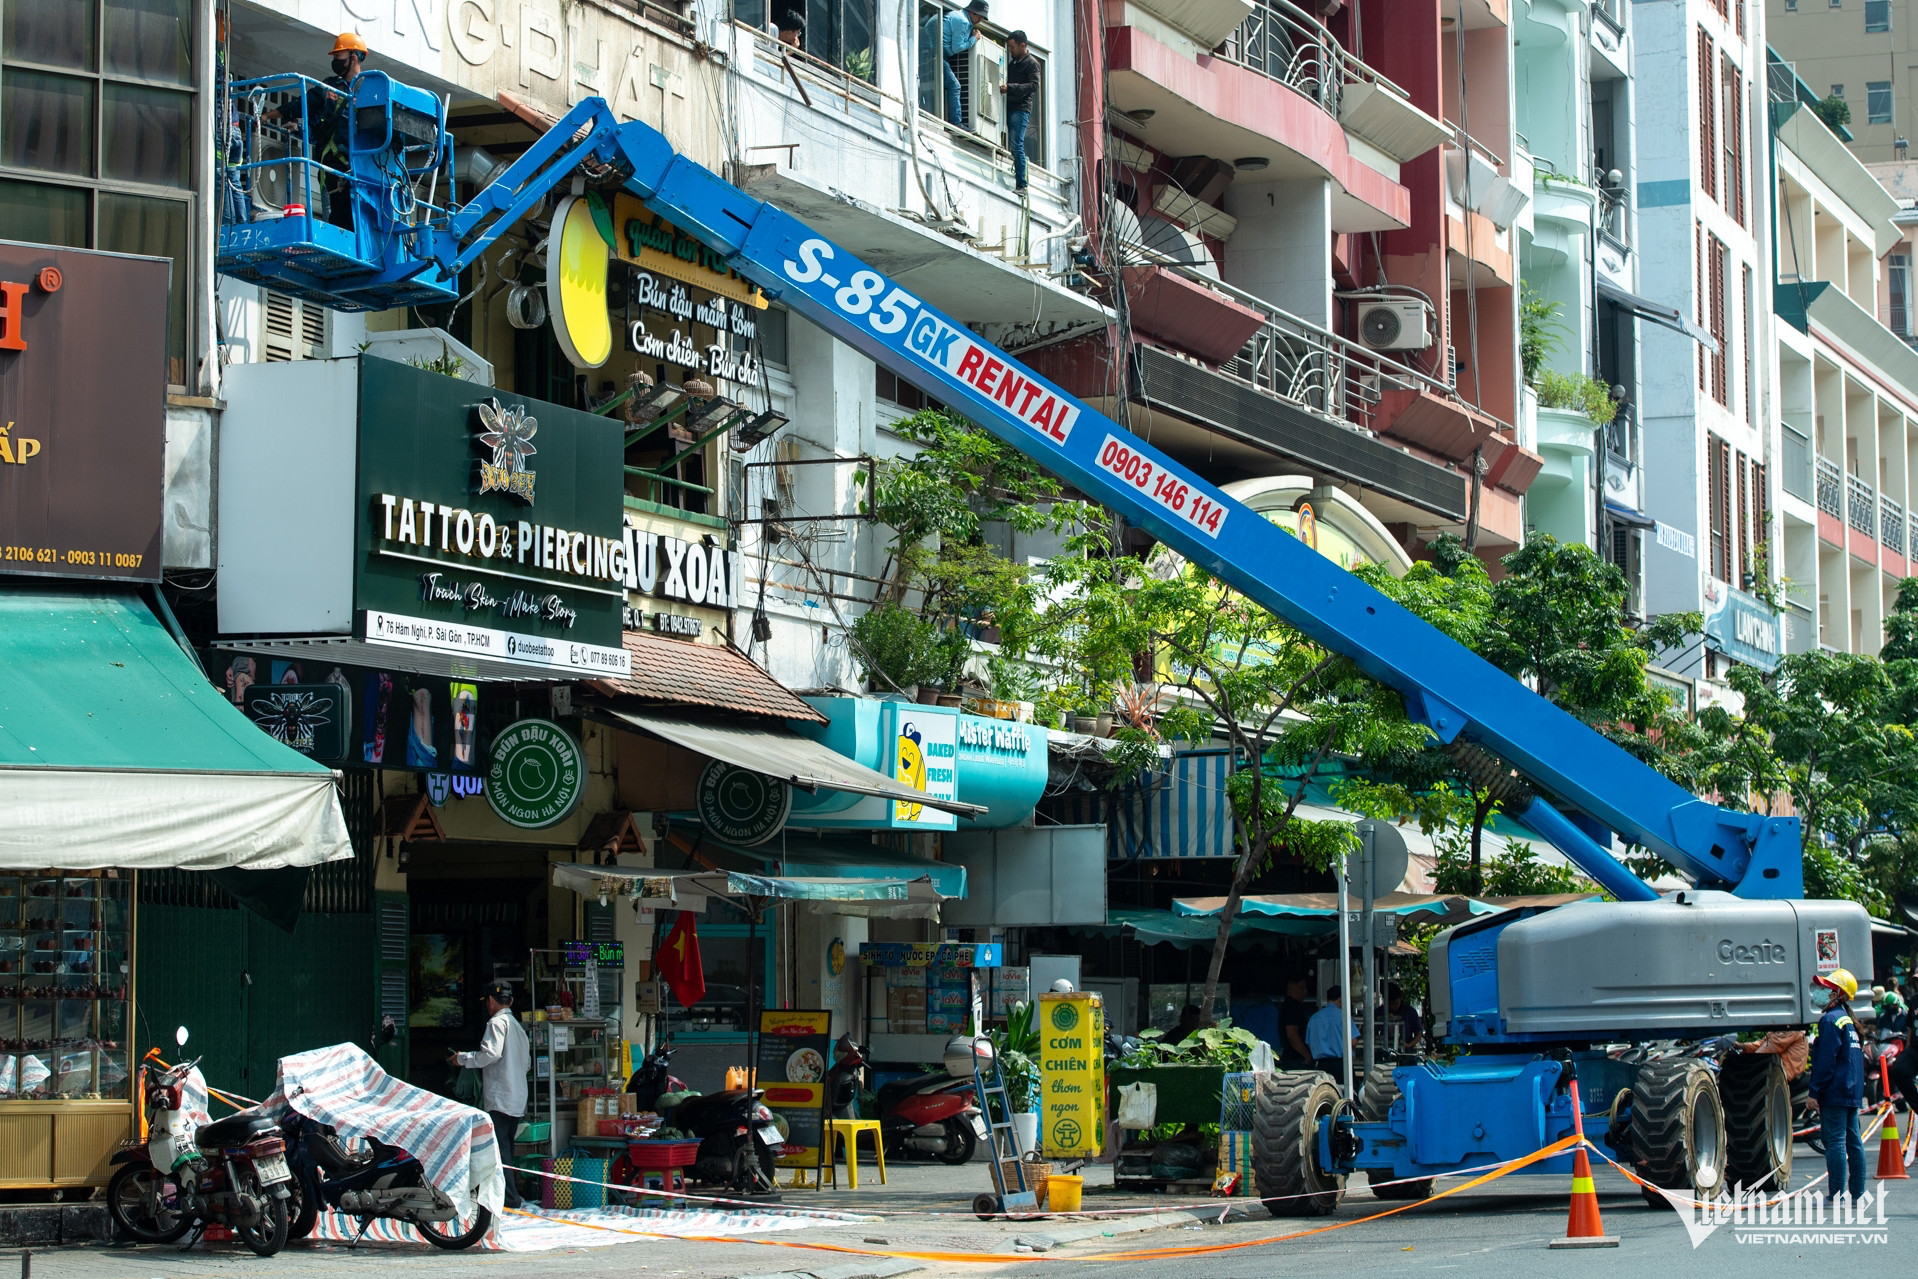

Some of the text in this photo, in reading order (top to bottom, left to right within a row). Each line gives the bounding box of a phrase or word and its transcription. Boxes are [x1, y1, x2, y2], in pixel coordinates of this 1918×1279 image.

[637, 272, 755, 340] Bún đậu mắm tôm
[632, 320, 664, 360] Cơm
[666, 329, 700, 370] chiên
[709, 345, 736, 381] Bún
[737, 351, 758, 387] chả
[784, 238, 1070, 443] S-85 GK RENTAL
[509, 470, 537, 508] BEE
[1101, 440, 1223, 533] 0903 146 114
[382, 493, 624, 582] TATTOO & PIERCING
[5, 546, 34, 562] 2106
[36, 548, 57, 563] 621
[67, 550, 96, 565] 0903
[99, 552, 112, 566] 11
[115, 553, 143, 568] 0087
[664, 534, 739, 609] XOÀI
[427, 572, 463, 602] Touch
[469, 581, 499, 610] Skin
[510, 589, 541, 618] Make
[547, 594, 578, 628] Story
[386, 620, 395, 634] 76
[395, 621, 410, 636] Hàm
[428, 626, 434, 639] P.
[435, 626, 447, 642] Sài
[448, 628, 463, 644] Gòn
[467, 631, 491, 648] TP.HCM
[517, 638, 555, 658] duobeetattoo
[590, 652, 600, 664] 077
[600, 653, 608, 665] 89
[608, 654, 619, 667] 606
[619, 656, 626, 668] 16
[495, 725, 574, 768] BÚN ĐẬU XOÀI
[927, 742, 955, 758] BAKED
[994, 726, 1032, 752] Waffle
[927, 768, 953, 784] FRESH
[491, 781, 571, 820] MÓN NGON HÀ NỘI
[599, 945, 615, 960] Bún
[863, 951, 882, 961] SINH
[1716, 938, 1786, 965] Genie
[1050, 1036, 1083, 1049] CƠM
[1045, 1056, 1087, 1071] CHIÊN
[1051, 1078, 1083, 1093] thơm
[1050, 1102, 1080, 1118] ngon
